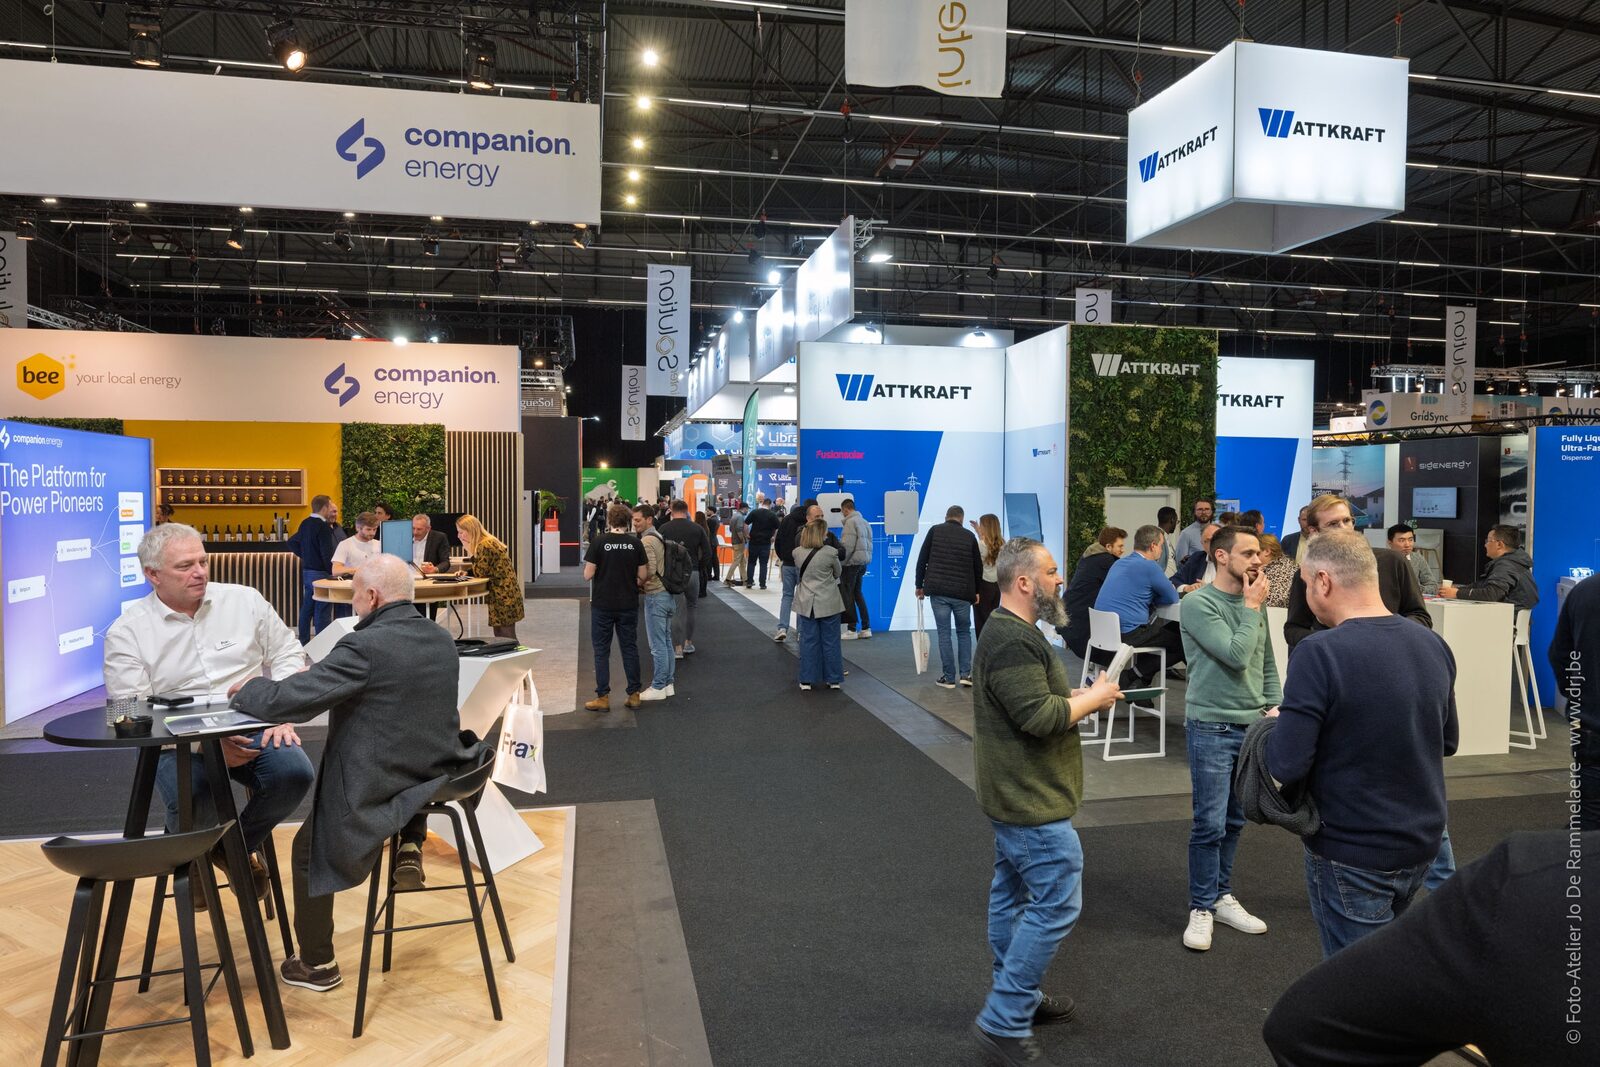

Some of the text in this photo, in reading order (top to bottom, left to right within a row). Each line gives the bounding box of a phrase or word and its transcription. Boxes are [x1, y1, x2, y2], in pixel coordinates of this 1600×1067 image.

[404, 125, 576, 156] companion.
[404, 155, 499, 187] energy
[23, 366, 182, 389] bee your local energy
[374, 390, 443, 410] energy
[1410, 409, 1449, 423] GridSync
[1561, 434, 1583, 443] Fully
[1561, 454, 1594, 462] Dispenser
[0, 462, 106, 488] The Platform for
[1, 490, 104, 516] Power Pioneers
